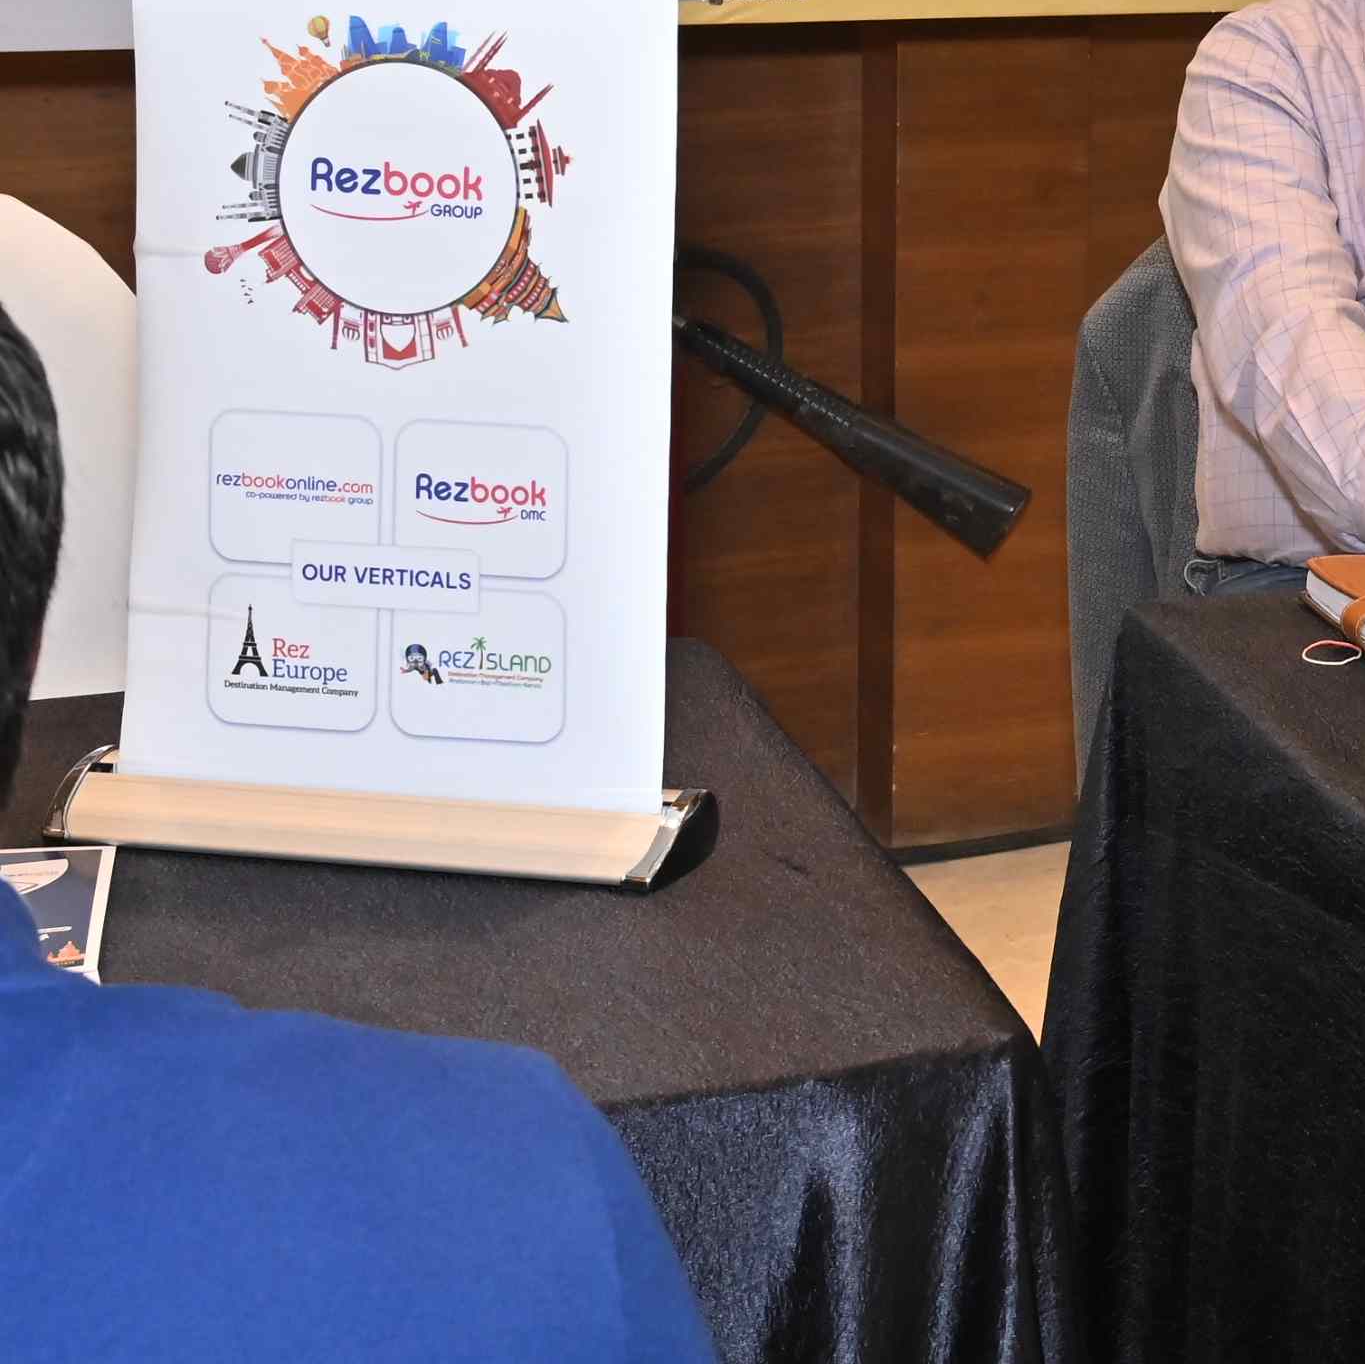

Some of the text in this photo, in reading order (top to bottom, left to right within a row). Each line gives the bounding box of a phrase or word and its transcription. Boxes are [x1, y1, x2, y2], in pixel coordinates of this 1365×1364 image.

[310, 156, 483, 202] Rezbook
[430, 203, 483, 220] GROUP
[216, 472, 374, 495] rezbookonline.com
[415, 472, 547, 507] Rezbook
[520, 509, 547, 522] DMC
[301, 562, 472, 590] OUR VERTICALS
[271, 637, 310, 659] Rez
[439, 650, 475, 669] REZ
[271, 658, 348, 685] Europe
[224, 679, 268, 691] Destination
